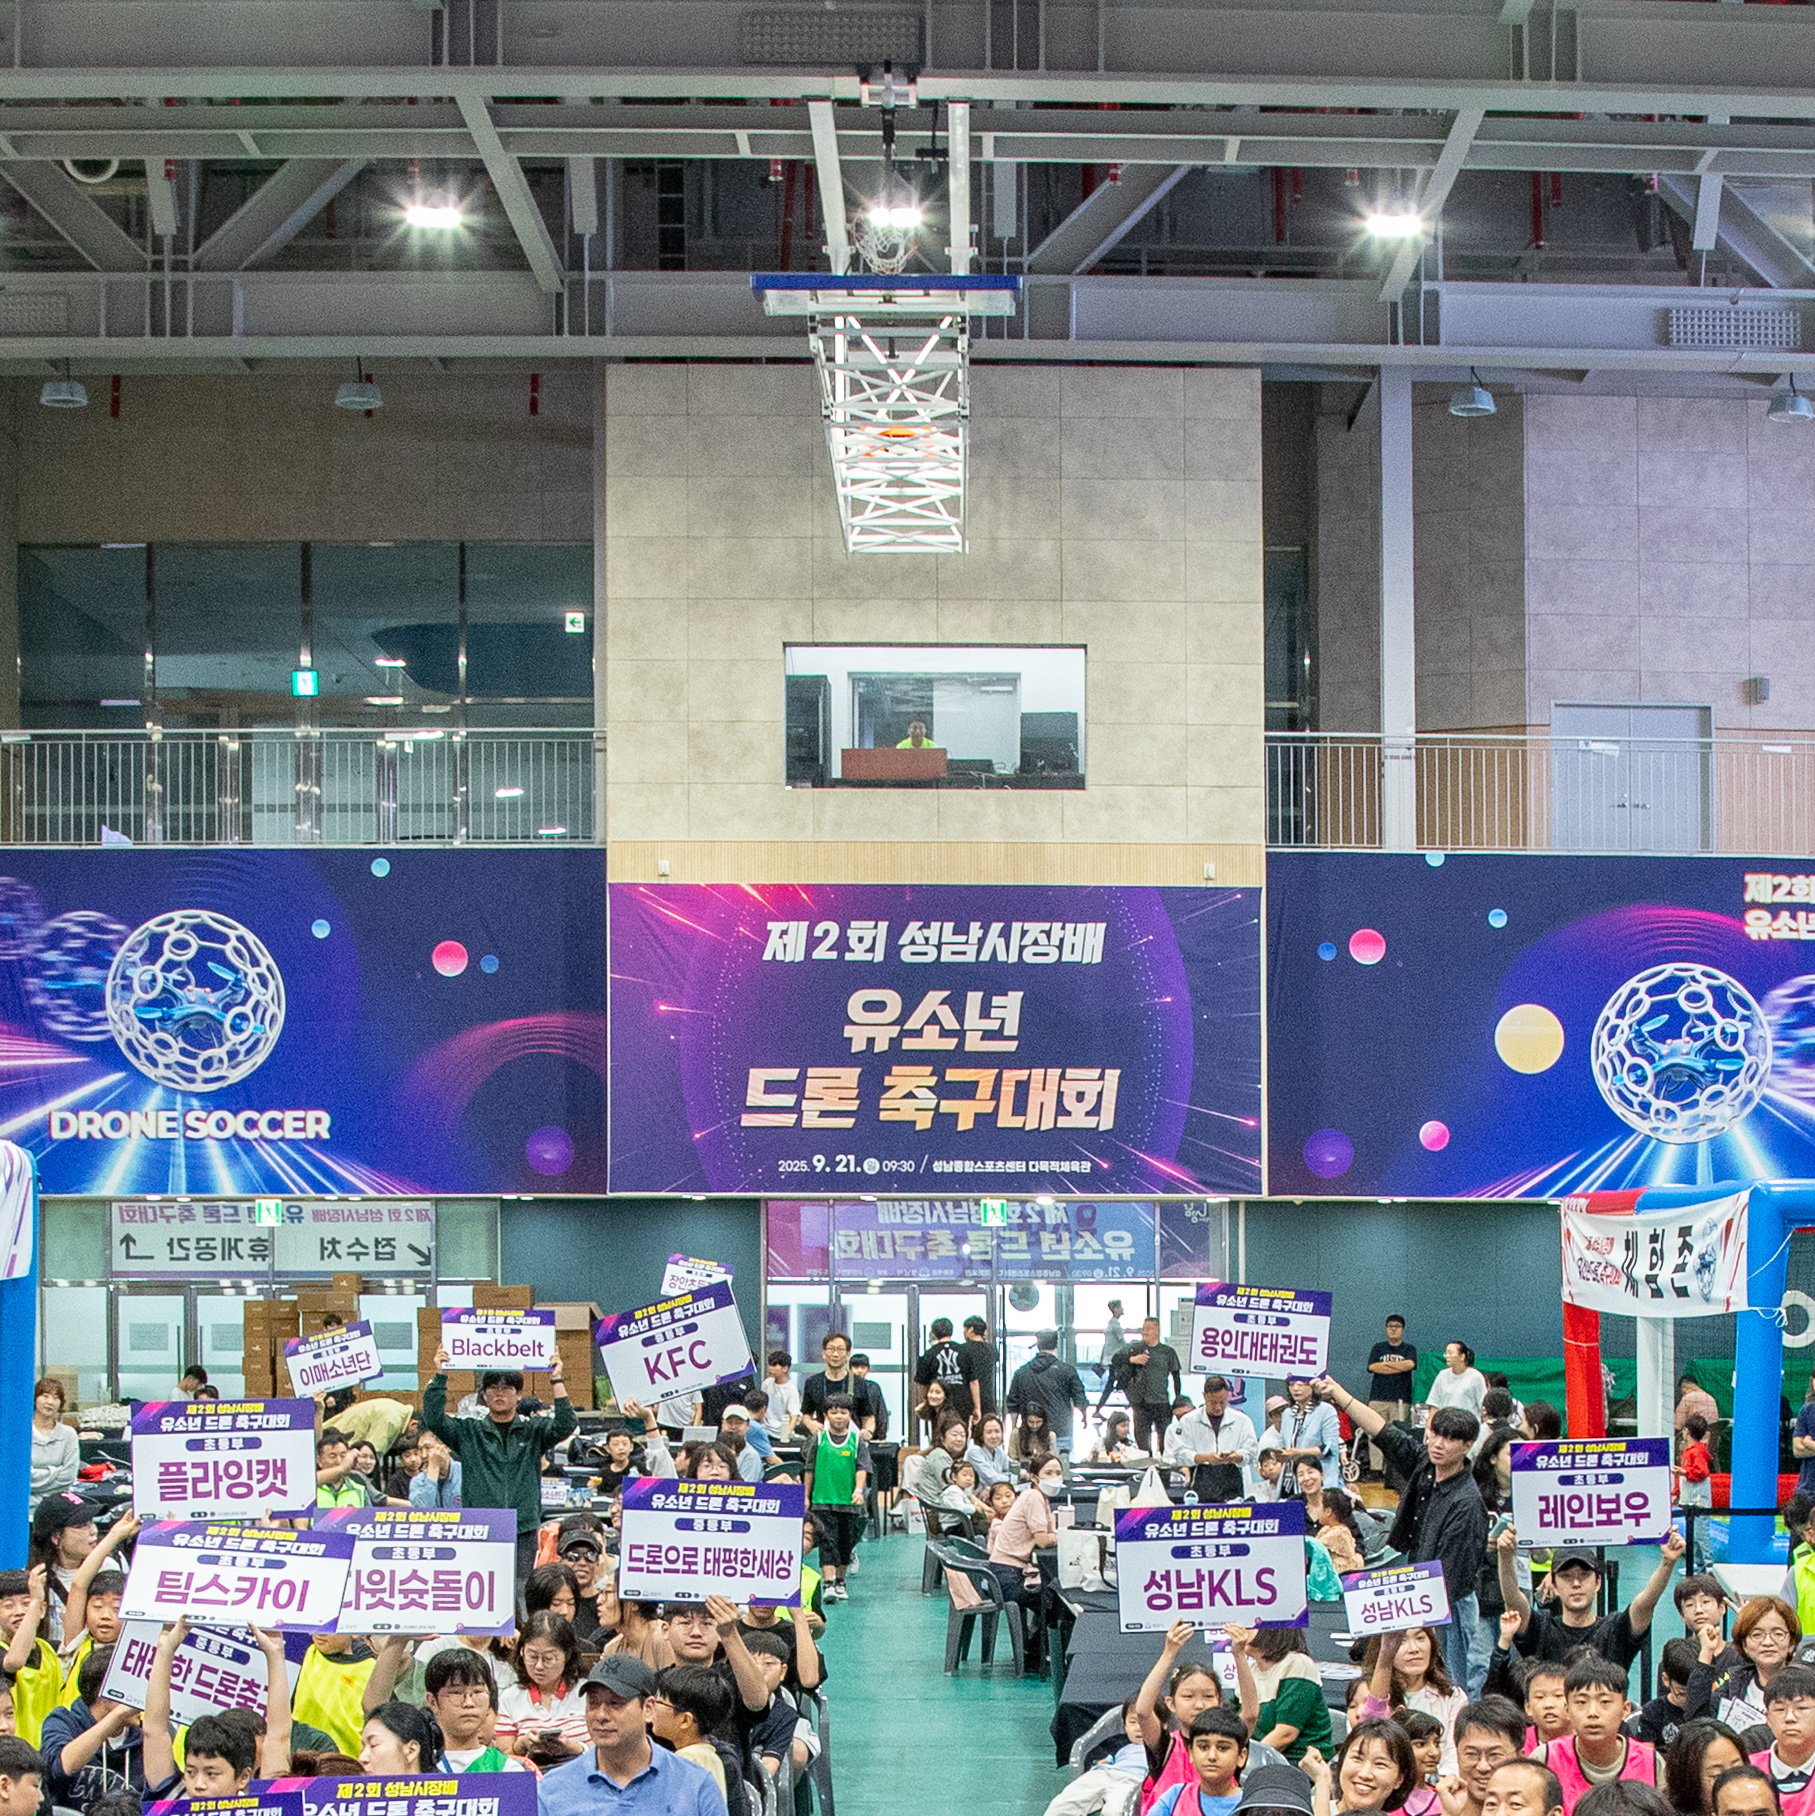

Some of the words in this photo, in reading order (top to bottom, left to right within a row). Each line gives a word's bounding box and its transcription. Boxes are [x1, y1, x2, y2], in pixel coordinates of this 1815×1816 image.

[762, 920, 889, 963] 제2회
[898, 921, 1107, 964] 성남시장배
[843, 988, 1024, 1053] 유소년
[740, 1067, 862, 1129] 드론
[879, 1065, 1121, 1132] 축구대회
[50, 1110, 179, 1139] DRONE
[184, 1110, 331, 1140] SOCCER
[778, 1160, 810, 1172] 2025.
[883, 1160, 915, 1172] 09:30
[933, 1160, 1026, 1173] 성남종합스포츠센터
[1029, 1160, 1091, 1173] 다목적체육관
[452, 1338, 544, 1357] Blackbelt
[643, 1340, 712, 1385] KFC
[1201, 1327, 1317, 1365] 용인대태권도
[299, 1350, 371, 1386] 이매소년단
[160, 1417, 201, 1431] 유소년
[205, 1415, 233, 1430] 드론
[237, 1414, 290, 1429] 축구대회
[157, 1457, 289, 1501] 플라잉캣
[1538, 1492, 1650, 1528] 레인보우
[172, 1532, 214, 1549] 유소년
[217, 1536, 248, 1552] 드론
[252, 1538, 326, 1556] 축구대회
[1145, 1522, 1187, 1538] 유소년
[1190, 1520, 1219, 1536] 드론
[1222, 1519, 1279, 1535] 축구대회
[627, 1544, 699, 1575] 드론으로
[704, 1547, 793, 1580] 태평한세상
[154, 1569, 310, 1613] 팀스카이
[1143, 1567, 1278, 1611] 성남KLS
[1361, 1594, 1433, 1624] 성남KLS
[336, 1783, 381, 1798] 제2회
[384, 1780, 459, 1796] 성남시장배
